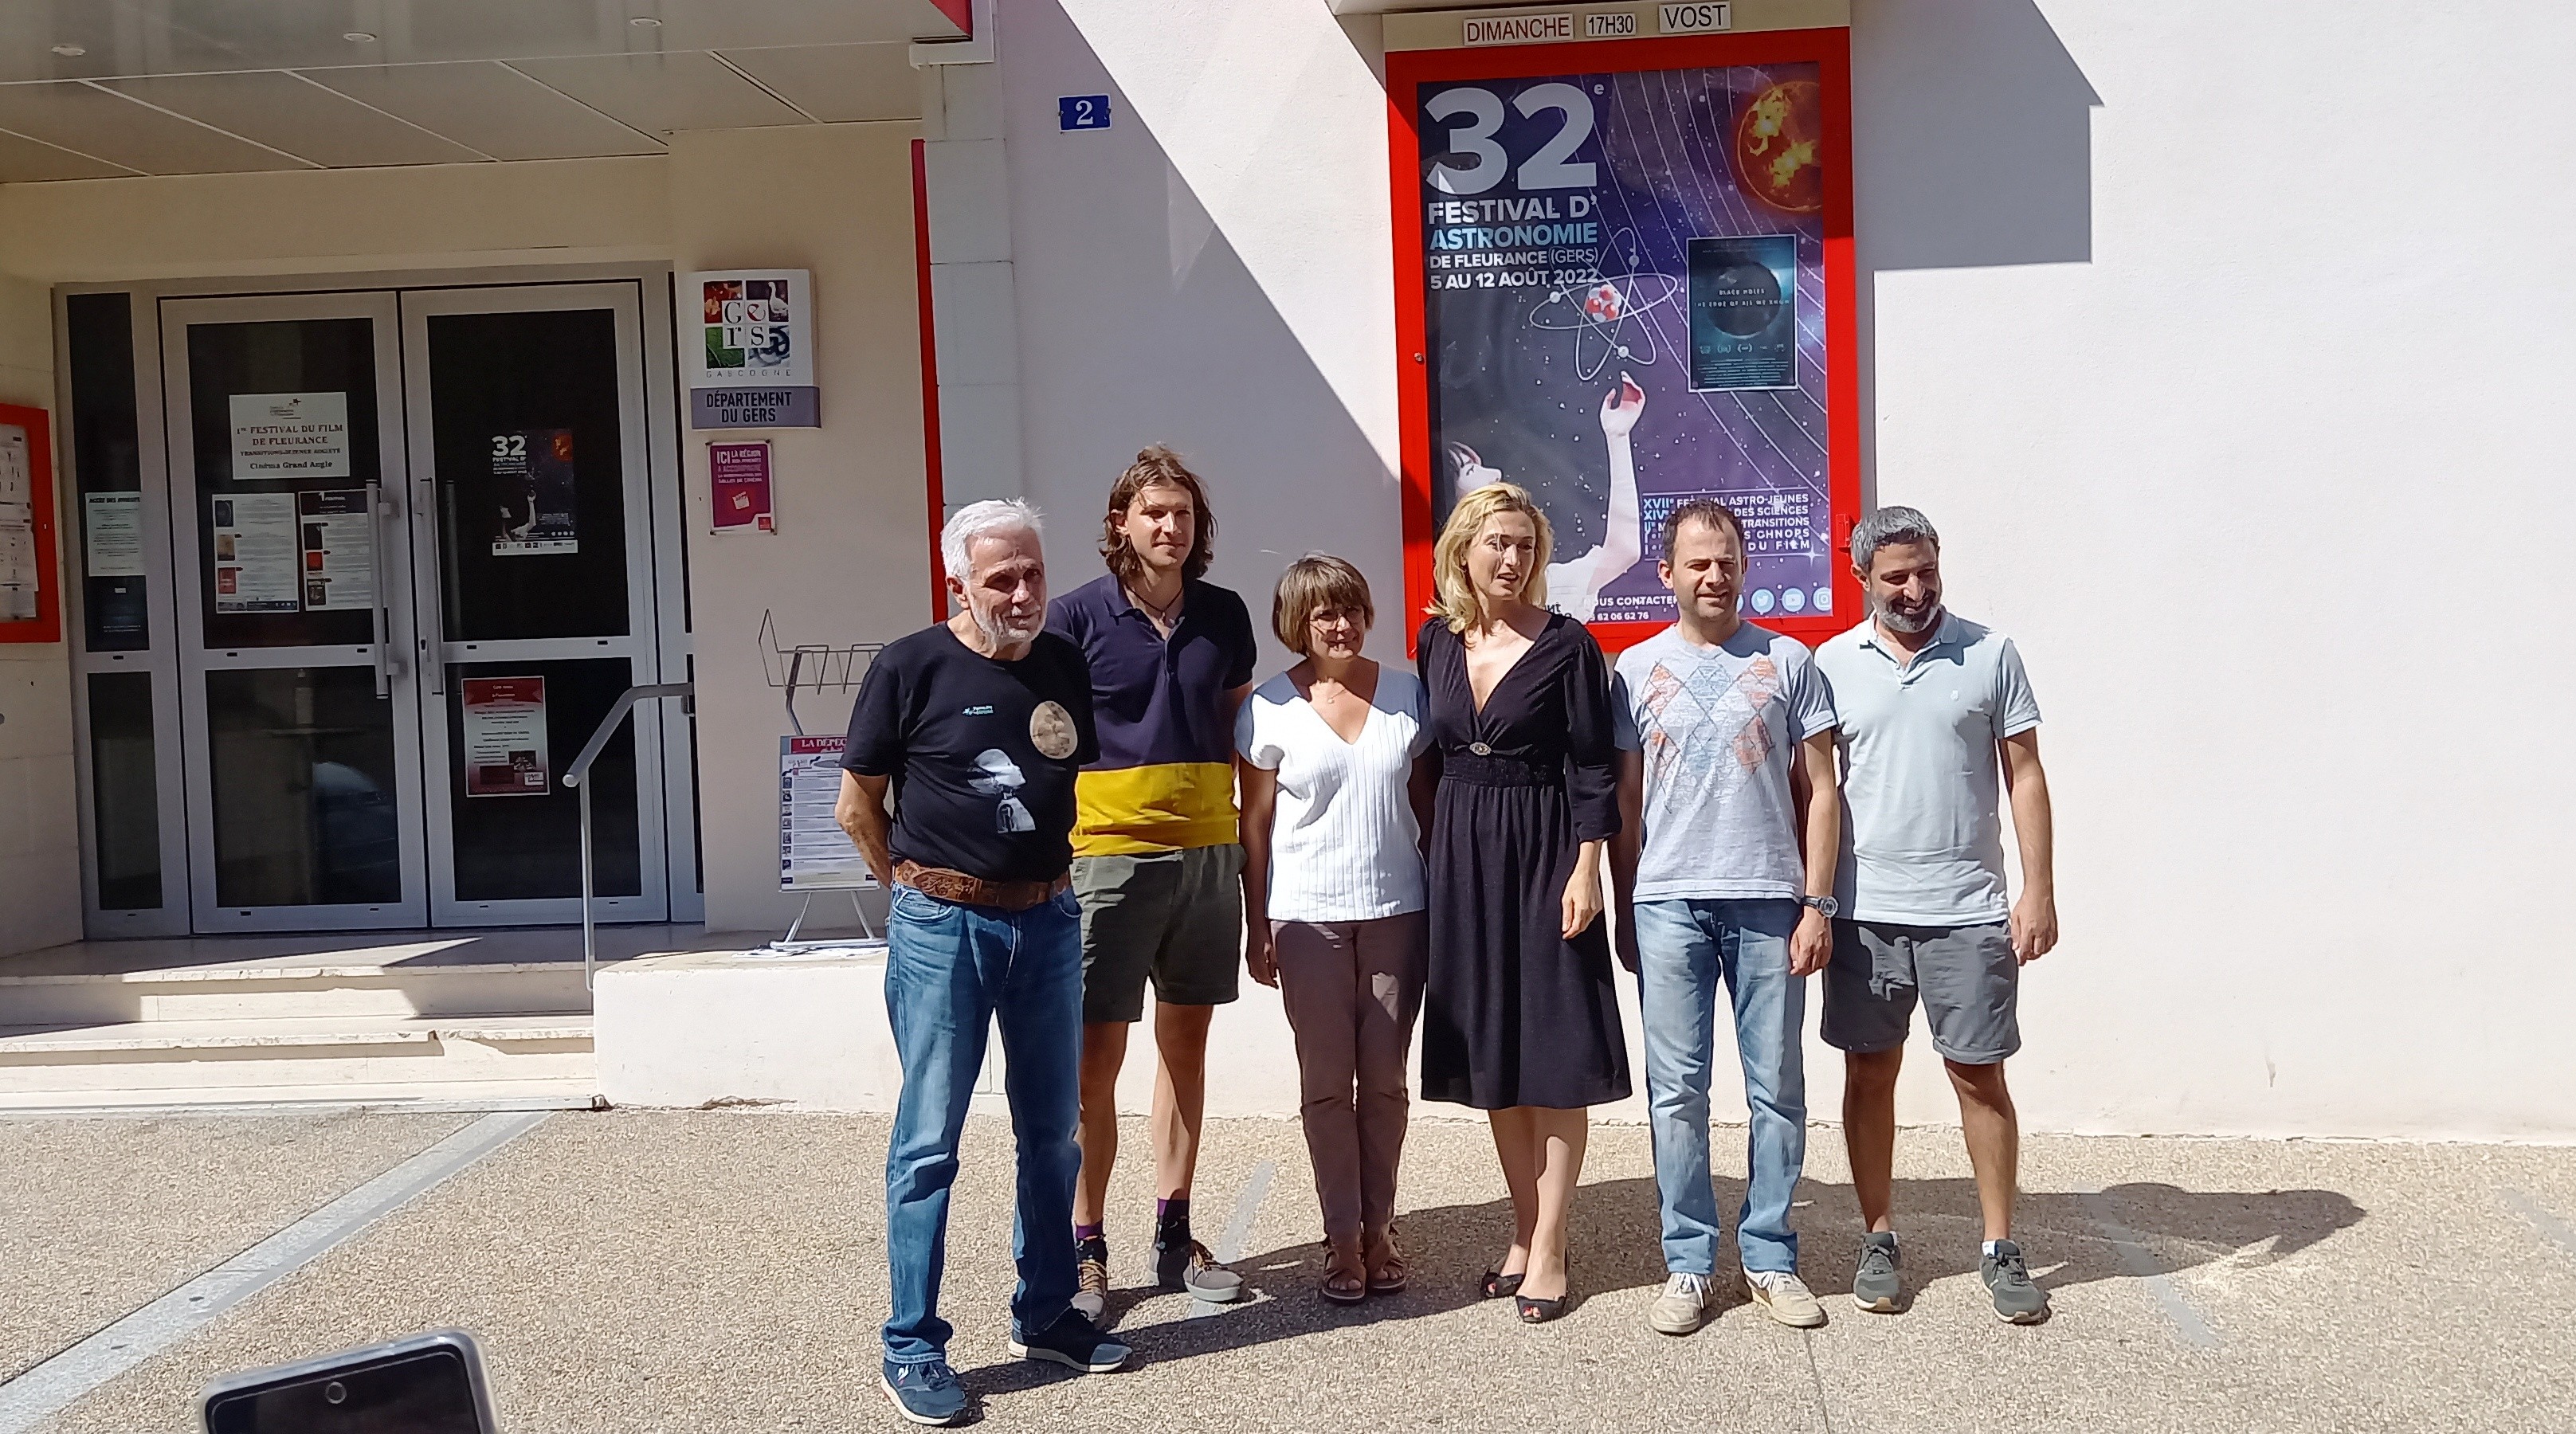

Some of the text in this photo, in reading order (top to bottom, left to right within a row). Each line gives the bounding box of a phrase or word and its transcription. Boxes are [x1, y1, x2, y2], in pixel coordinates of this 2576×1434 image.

[1466, 4, 1727, 42] DIMANCHE 17H30 VOST
[1075, 100, 1094, 126] 2
[1428, 198, 1561, 225] FESTIVAL
[1429, 221, 1598, 251] ASTRONOMIE
[1429, 247, 1599, 269] DE FLEURANCE (GERS)
[1430, 275, 1442, 290] 5
[1445, 272, 1472, 290] AU
[1475, 272, 1496, 288] 12
[1553, 268, 1598, 285] 2022
[706, 369, 791, 378] GASCOGNE
[706, 390, 792, 408] DÉPARTEMENT
[721, 407, 776, 423] DU GERS
[250, 425, 299, 434] FESTIVAL
[318, 424, 343, 433] FILM
[253, 436, 328, 446] DE FLEURANCE
[716, 450, 731, 464] ICI
[282, 460, 308, 469] Grand
[1734, 507, 1755, 517] DES
[1757, 505, 1809, 515] SCIENCES
[1741, 517, 1810, 529] TRANSITIONS
[1747, 541, 1767, 551] DU
[801, 739, 815, 748] LA
